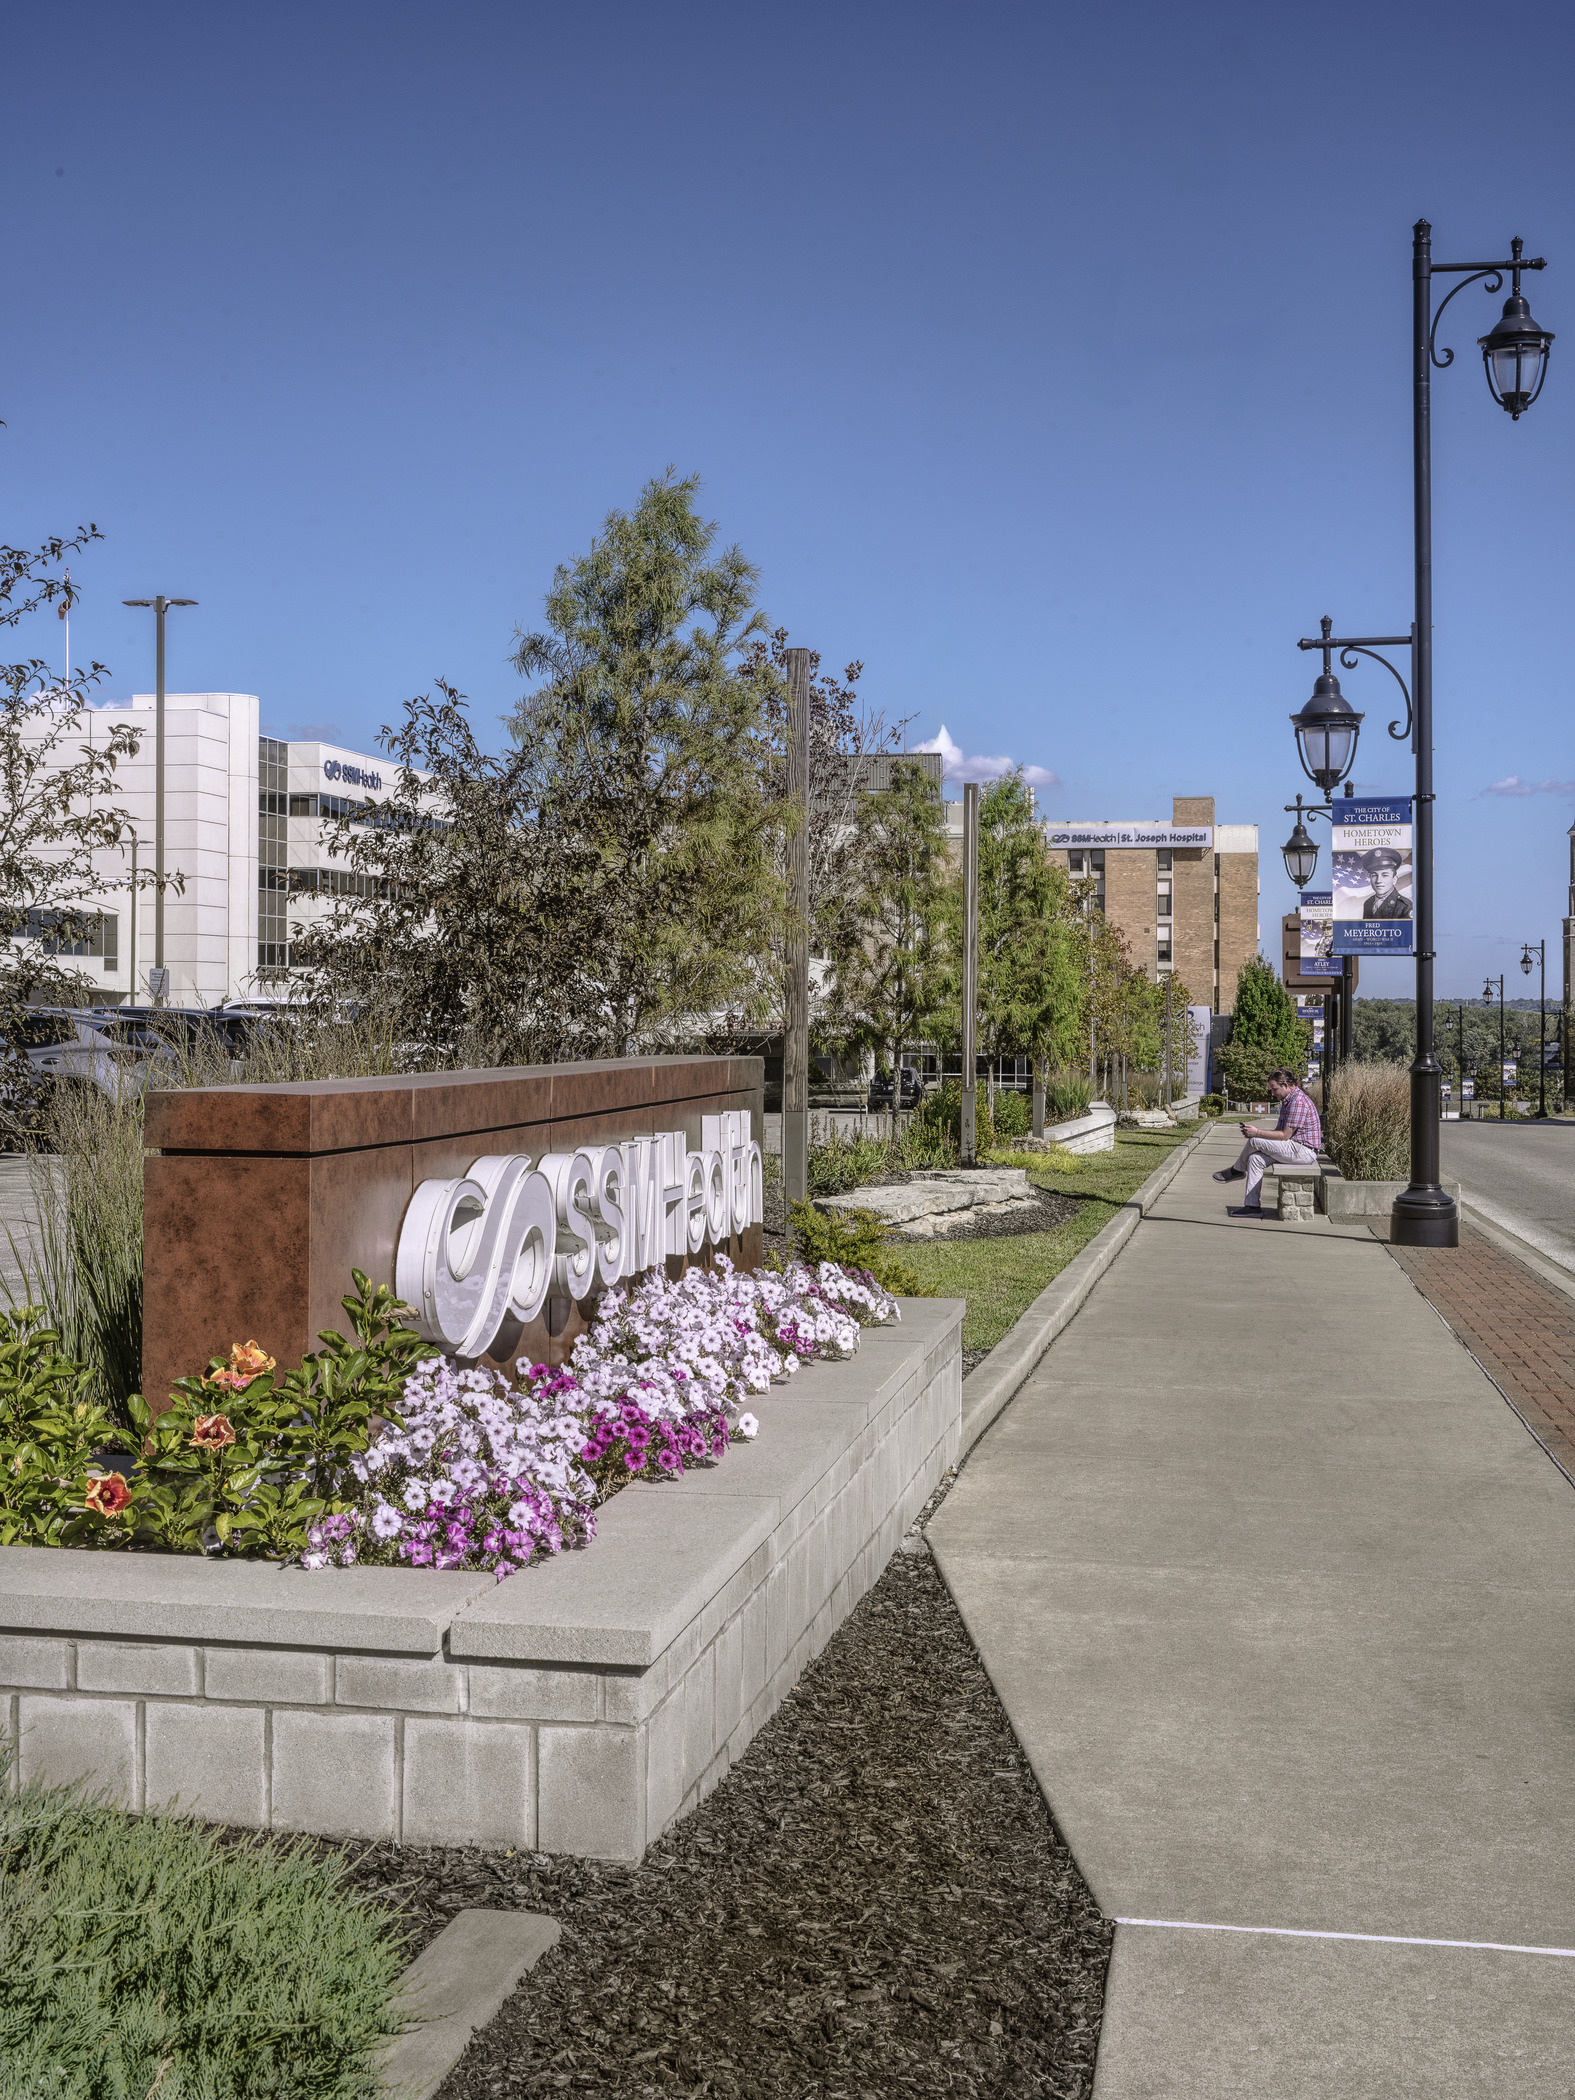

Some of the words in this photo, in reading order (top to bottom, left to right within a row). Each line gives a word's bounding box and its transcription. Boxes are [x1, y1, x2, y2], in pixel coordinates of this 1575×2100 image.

[1343, 814, 1357, 823] ST.
[1358, 813, 1401, 822] CHARLES
[1121, 833, 1133, 842] St.
[1135, 833, 1167, 843] Joseph
[1169, 832, 1207, 843] Hospital
[1343, 828, 1402, 838] HOMETOWN
[1354, 838, 1391, 846] HEROES
[1343, 928, 1402, 938] MEYEROTTO
